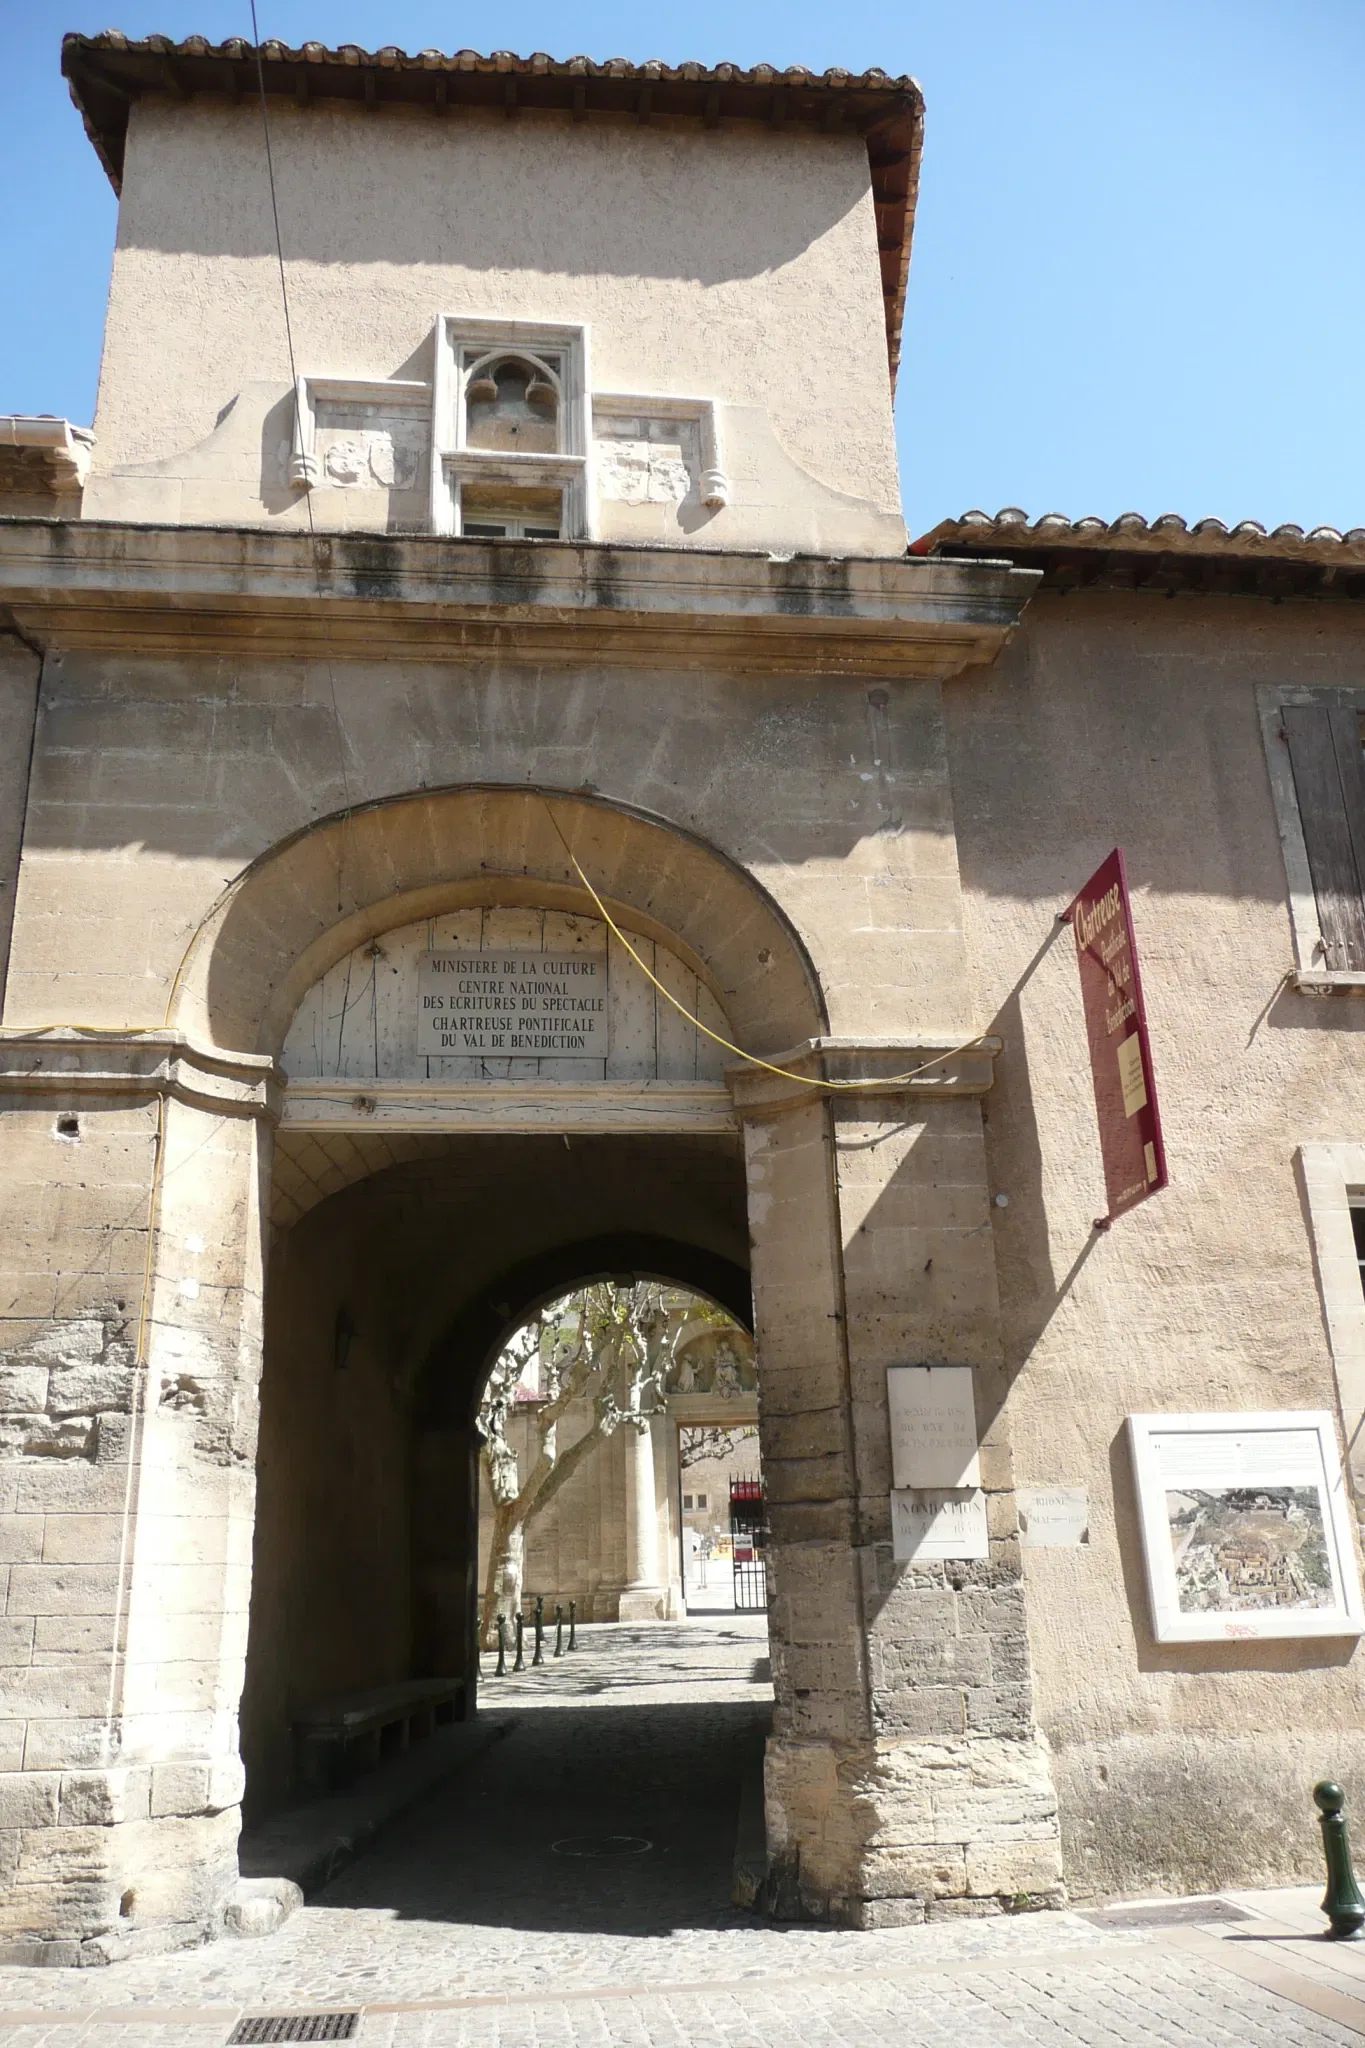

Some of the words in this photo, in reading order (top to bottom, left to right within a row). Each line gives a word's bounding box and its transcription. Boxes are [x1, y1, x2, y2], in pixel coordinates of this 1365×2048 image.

[1075, 882, 1120, 951] Chartreuse
[431, 960, 498, 974] MINISTERE
[503, 961, 517, 974] DE
[522, 962, 536, 975] LA
[543, 962, 597, 976] CULTURE
[458, 980, 505, 994] CENTRE
[509, 981, 568, 995] NATIONAL
[423, 996, 444, 1009] DES
[449, 997, 516, 1010] ECRITURES
[521, 997, 537, 1010] DU
[542, 998, 604, 1012] SPECTACLE
[432, 1017, 513, 1031] CHARTREUSE
[518, 1018, 595, 1032] PONTIFICALE
[441, 1034, 457, 1047] DU
[464, 1034, 486, 1047] VAL
[491, 1035, 505, 1048] DE
[511, 1035, 585, 1049] BENEDICTION
[897, 1502, 982, 1516] INONDATION
